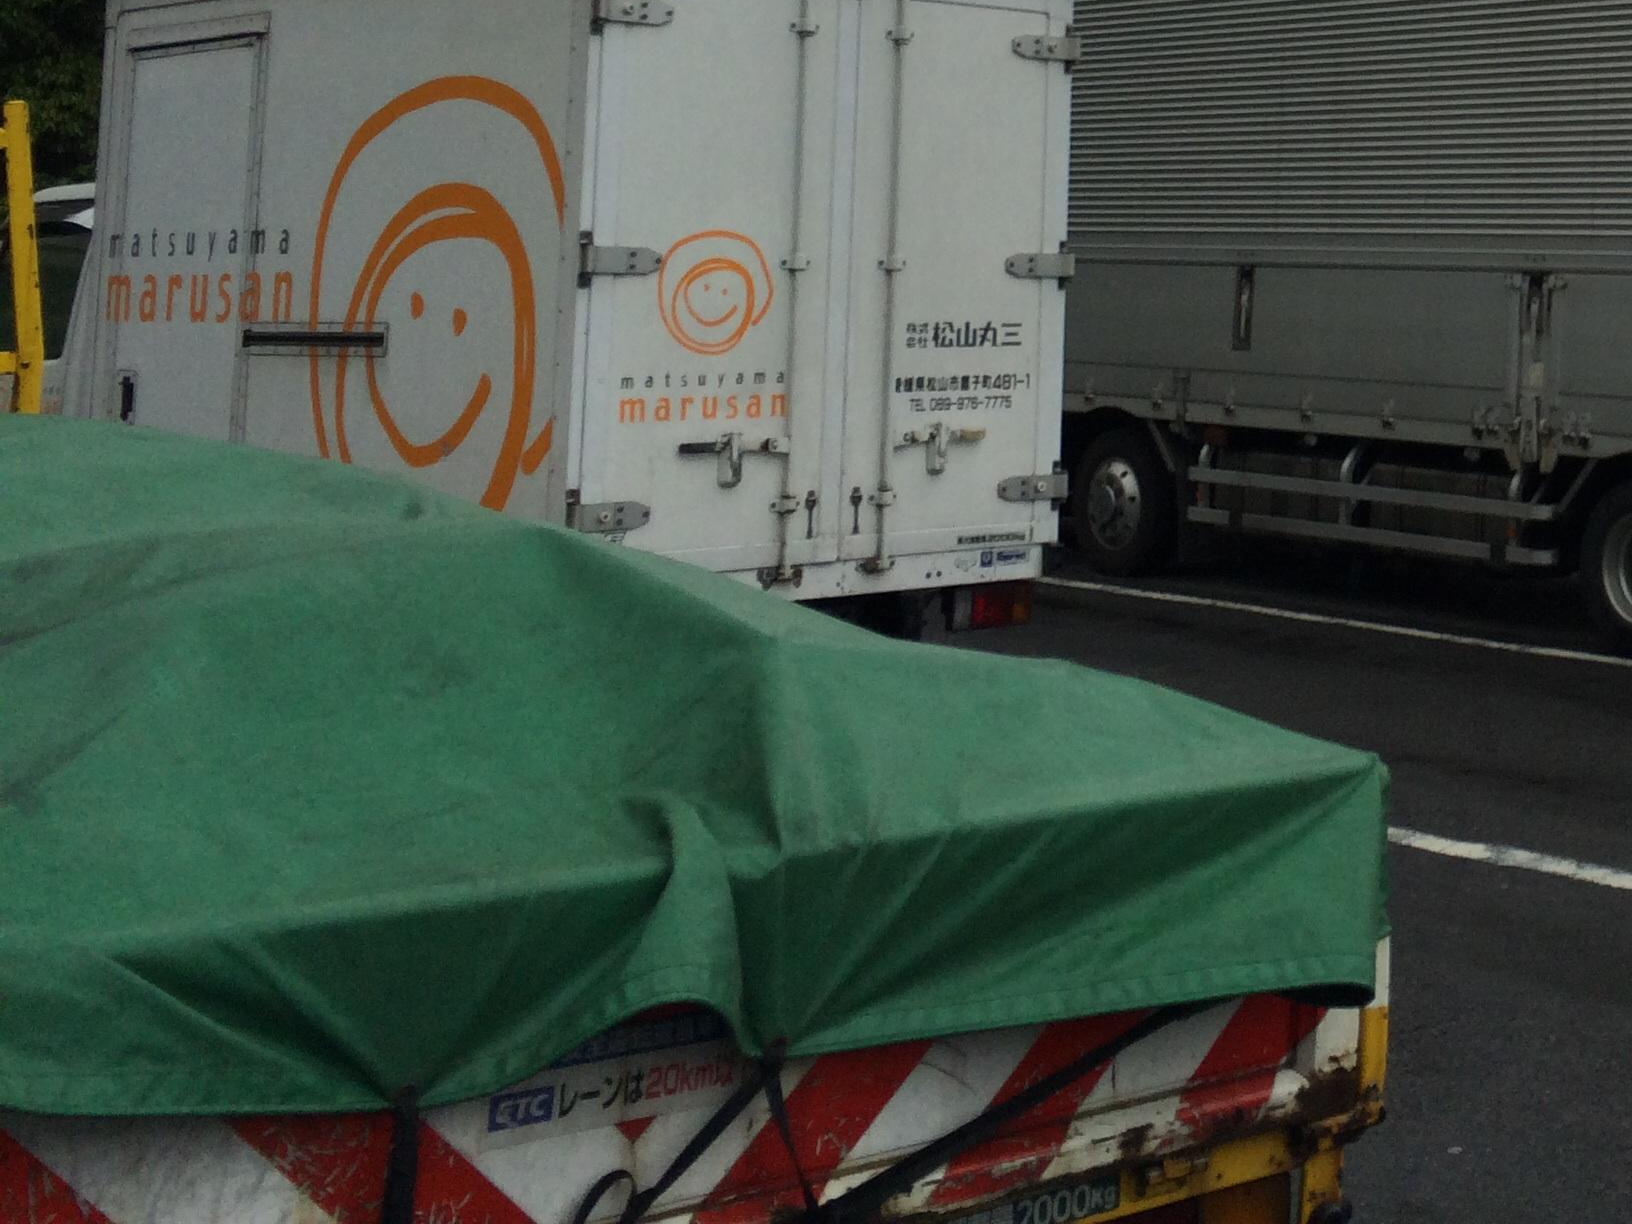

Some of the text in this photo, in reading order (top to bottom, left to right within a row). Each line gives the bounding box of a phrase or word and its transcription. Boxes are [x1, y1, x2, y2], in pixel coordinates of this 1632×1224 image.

[108, 227, 291, 262] matsuyama
[106, 271, 294, 324] marusan
[620, 371, 785, 390] matsuyama
[619, 393, 787, 424] marusan
